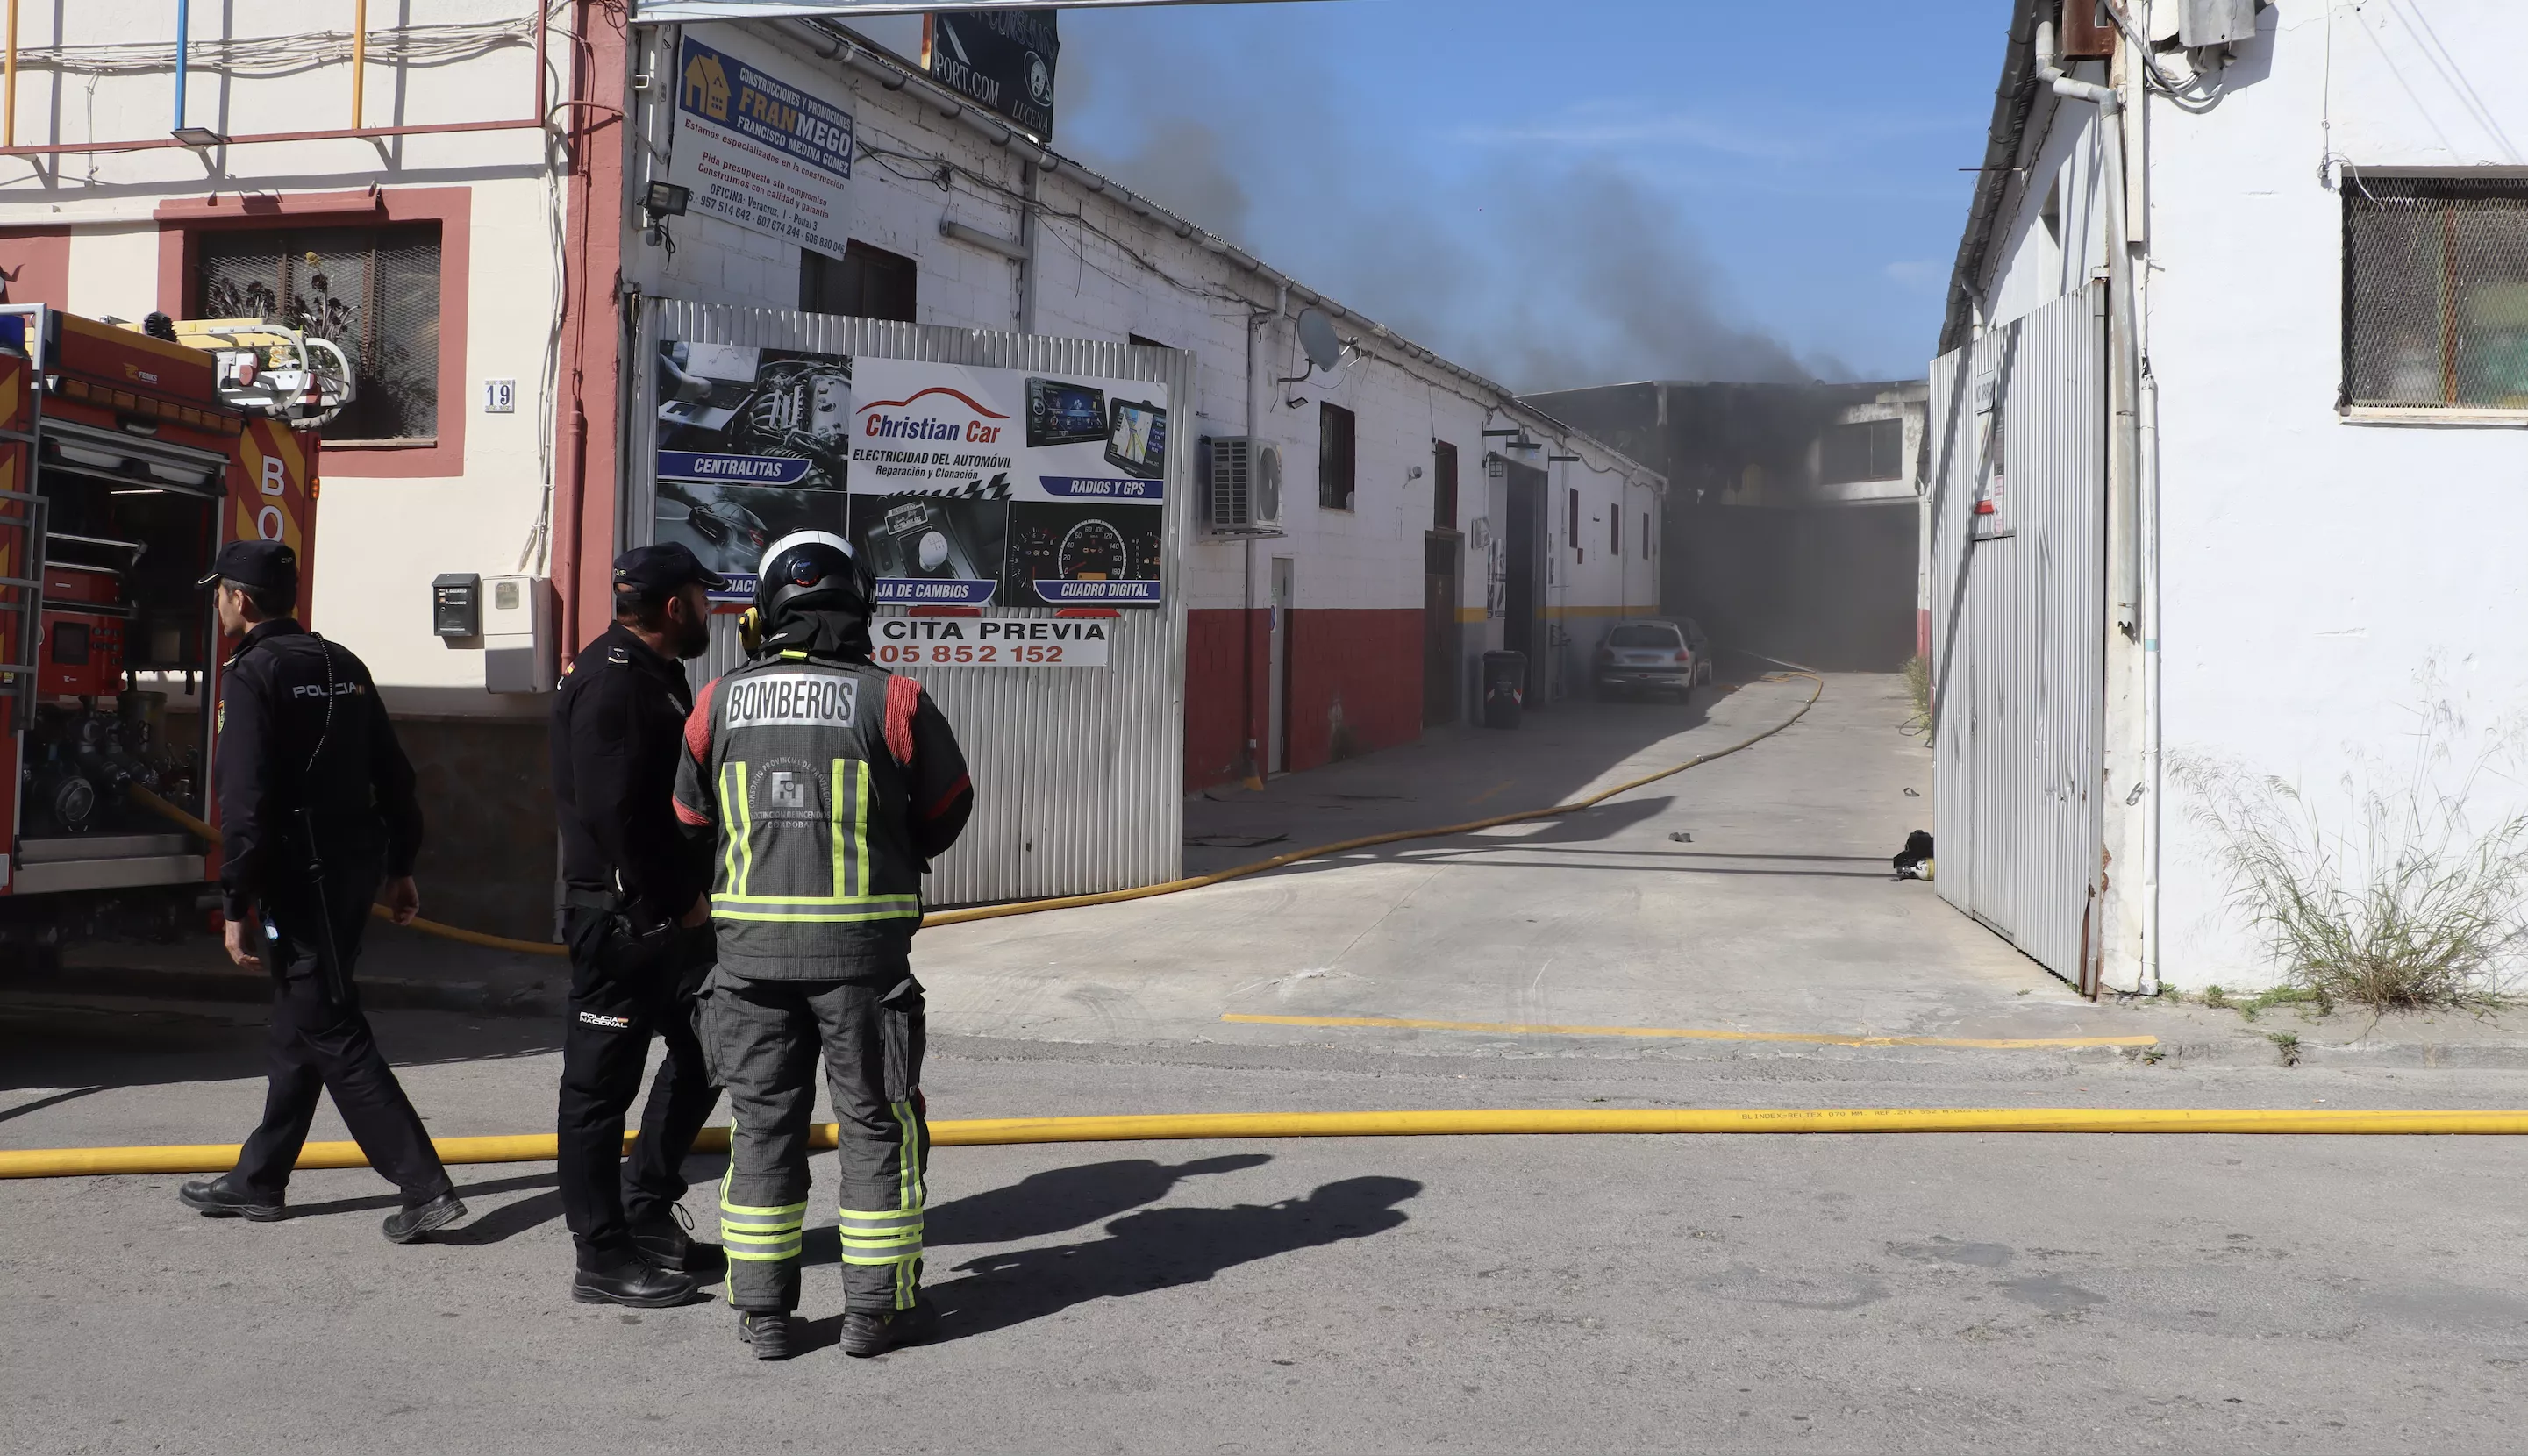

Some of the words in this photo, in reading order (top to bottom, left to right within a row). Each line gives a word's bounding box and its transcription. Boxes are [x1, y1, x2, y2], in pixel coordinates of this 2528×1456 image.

[740, 67, 800, 108] CONSTRUCCIONES
[801, 95, 807, 107] Y
[808, 102, 851, 131] PROMOCIONES
[1012, 99, 1048, 134] LUCENA
[685, 118, 719, 140] Estamos
[722, 135, 780, 164] especializados
[782, 159, 790, 168] en
[793, 161, 800, 173] la
[737, 115, 786, 147] FRANCISCO
[788, 139, 821, 162] MEDINA
[822, 153, 849, 175] GOMEZ
[697, 162, 749, 189] Construimos
[751, 184, 765, 195] con
[767, 189, 795, 206] calidad
[796, 200, 800, 209] y
[703, 152, 720, 166] Pida
[722, 161, 771, 185] presupuesto
[773, 175, 785, 189] sin
[787, 184, 827, 207] compromiso
[710, 183, 746, 204] OFICINA:
[793, 213, 811, 229] Portal
[812, 222, 818, 232] 3
[700, 195, 717, 210] 957
[718, 201, 733, 216] 514
[735, 206, 751, 221] 642
[756, 214, 771, 229] 607
[771, 219, 785, 233] 674
[786, 225, 800, 239] 244
[804, 232, 818, 246] 606
[819, 236, 832, 250] 830
[487, 385, 511, 405] 19
[865, 413, 960, 441] Christian
[966, 420, 1001, 443] Car
[694, 458, 782, 477] CENTRALITAS
[853, 449, 929, 464] ELECTRICIDAD
[932, 453, 950, 465] DEL
[953, 453, 1012, 468] AUTOMÓVIL
[875, 465, 925, 479] Reparación
[927, 470, 932, 479] y
[935, 467, 978, 480] Clonación
[1070, 480, 1111, 494] RADIOS
[1114, 482, 1121, 494] Y
[1123, 482, 1146, 496] GPS
[875, 584, 894, 597] JA
[896, 584, 913, 597] DE
[915, 584, 969, 598] CAMBIOS
[1060, 583, 1106, 596] CUADRO
[1108, 583, 1149, 596] DIGITAL
[882, 621, 964, 639] CITA
[979, 622, 1106, 640] PREVIA
[932, 645, 997, 663] 852
[1010, 646, 1063, 663] 152
[730, 681, 853, 723] BOMBEROS
[748, 770, 764, 809] CONSORCIO
[762, 757, 801, 772] PROVINCIAL
[802, 760, 811, 770] DE
[579, 1017, 628, 1028] NACIONAL
[580, 1011, 618, 1024] POLICIA
